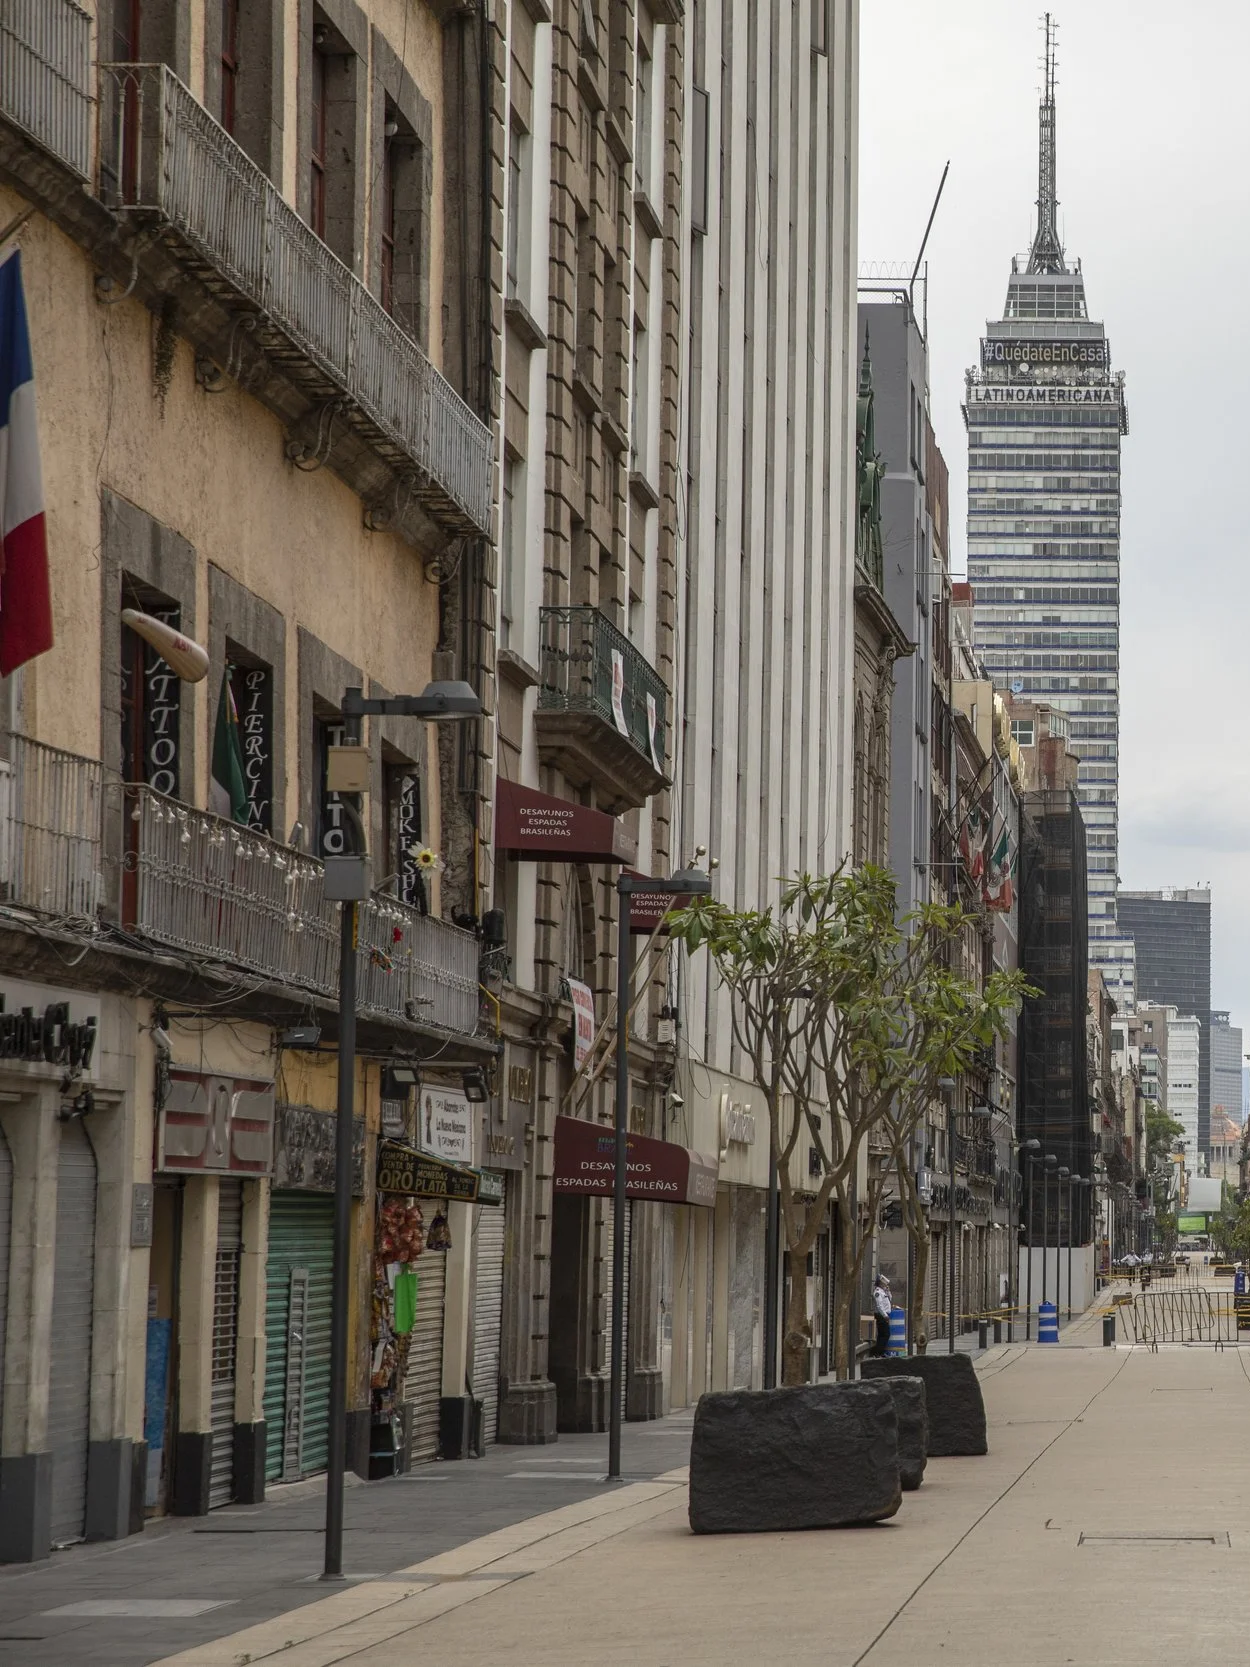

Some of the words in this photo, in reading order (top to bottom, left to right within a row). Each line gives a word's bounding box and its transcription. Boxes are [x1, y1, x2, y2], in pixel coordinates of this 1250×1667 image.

[984, 341, 1104, 362] #QuédateEnCasa
[975, 388, 1112, 401] LATINOAMERICANA
[519, 808, 574, 818] DESAYUNOS
[528, 818, 568, 826] ESPADAS
[520, 827, 571, 837] BRASILEÑAS
[629, 908, 663, 916] BRASILEÑ
[383, 1160, 405, 1170] VENTA
[406, 1162, 414, 1171] DE
[580, 1161, 651, 1172] DESAYNOS
[379, 1169, 413, 1190] ORO
[416, 1170, 448, 1181] MONEDAS
[415, 1178, 447, 1194] PLATA
[555, 1176, 606, 1187] ESPADAS
[612, 1178, 678, 1191] ASILEÑAS
